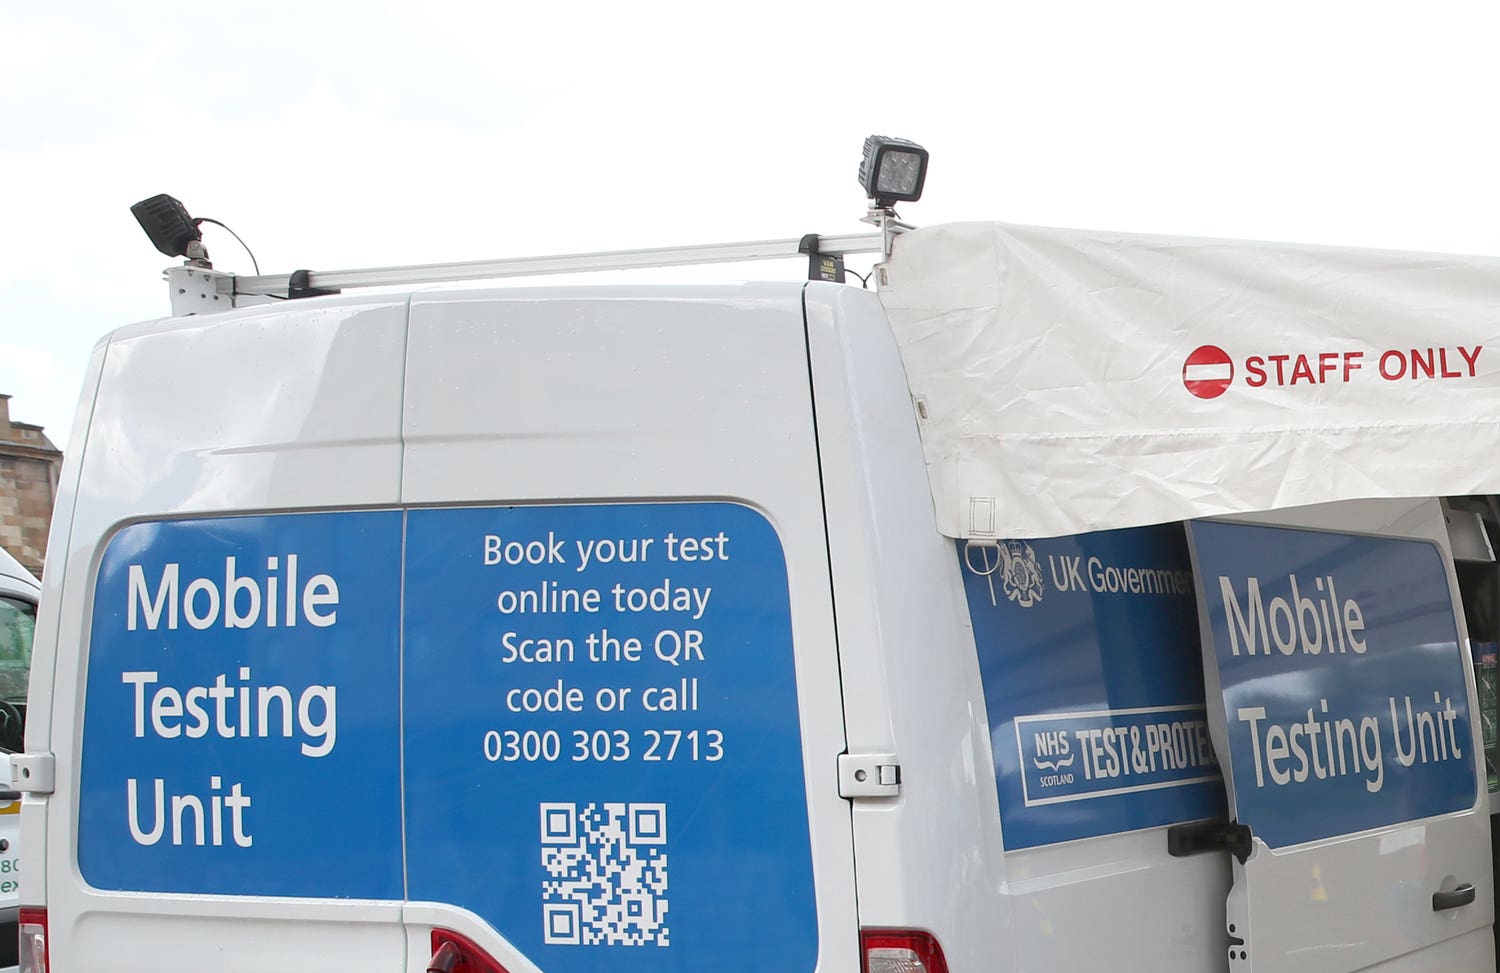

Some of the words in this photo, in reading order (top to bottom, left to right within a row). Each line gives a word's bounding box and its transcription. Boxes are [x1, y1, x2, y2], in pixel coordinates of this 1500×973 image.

[1245, 352, 1364, 387] STAFF
[1379, 346, 1483, 381] ONLY
[483, 532, 566, 566] Book
[576, 538, 653, 572] your
[664, 532, 729, 562] test
[127, 554, 340, 631] Mobile
[1049, 555, 1087, 592] UK
[497, 581, 601, 615] online
[612, 579, 711, 620] today
[1218, 574, 1367, 658] Mobile
[502, 632, 574, 664] Scan
[586, 629, 642, 662] the
[654, 630, 705, 666] QR
[122, 667, 337, 758] Testing
[506, 679, 584, 713] code
[595, 686, 632, 713] or
[642, 678, 699, 712] call
[483, 730, 560, 762] 0300
[572, 730, 630, 761] 303
[643, 729, 725, 762] 2713
[1034, 731, 1070, 757] NHS
[1237, 698, 1383, 793] Testing
[1388, 692, 1462, 768] Unit
[1040, 773, 1074, 787] SCOTLAND
[126, 775, 254, 848] Unit
